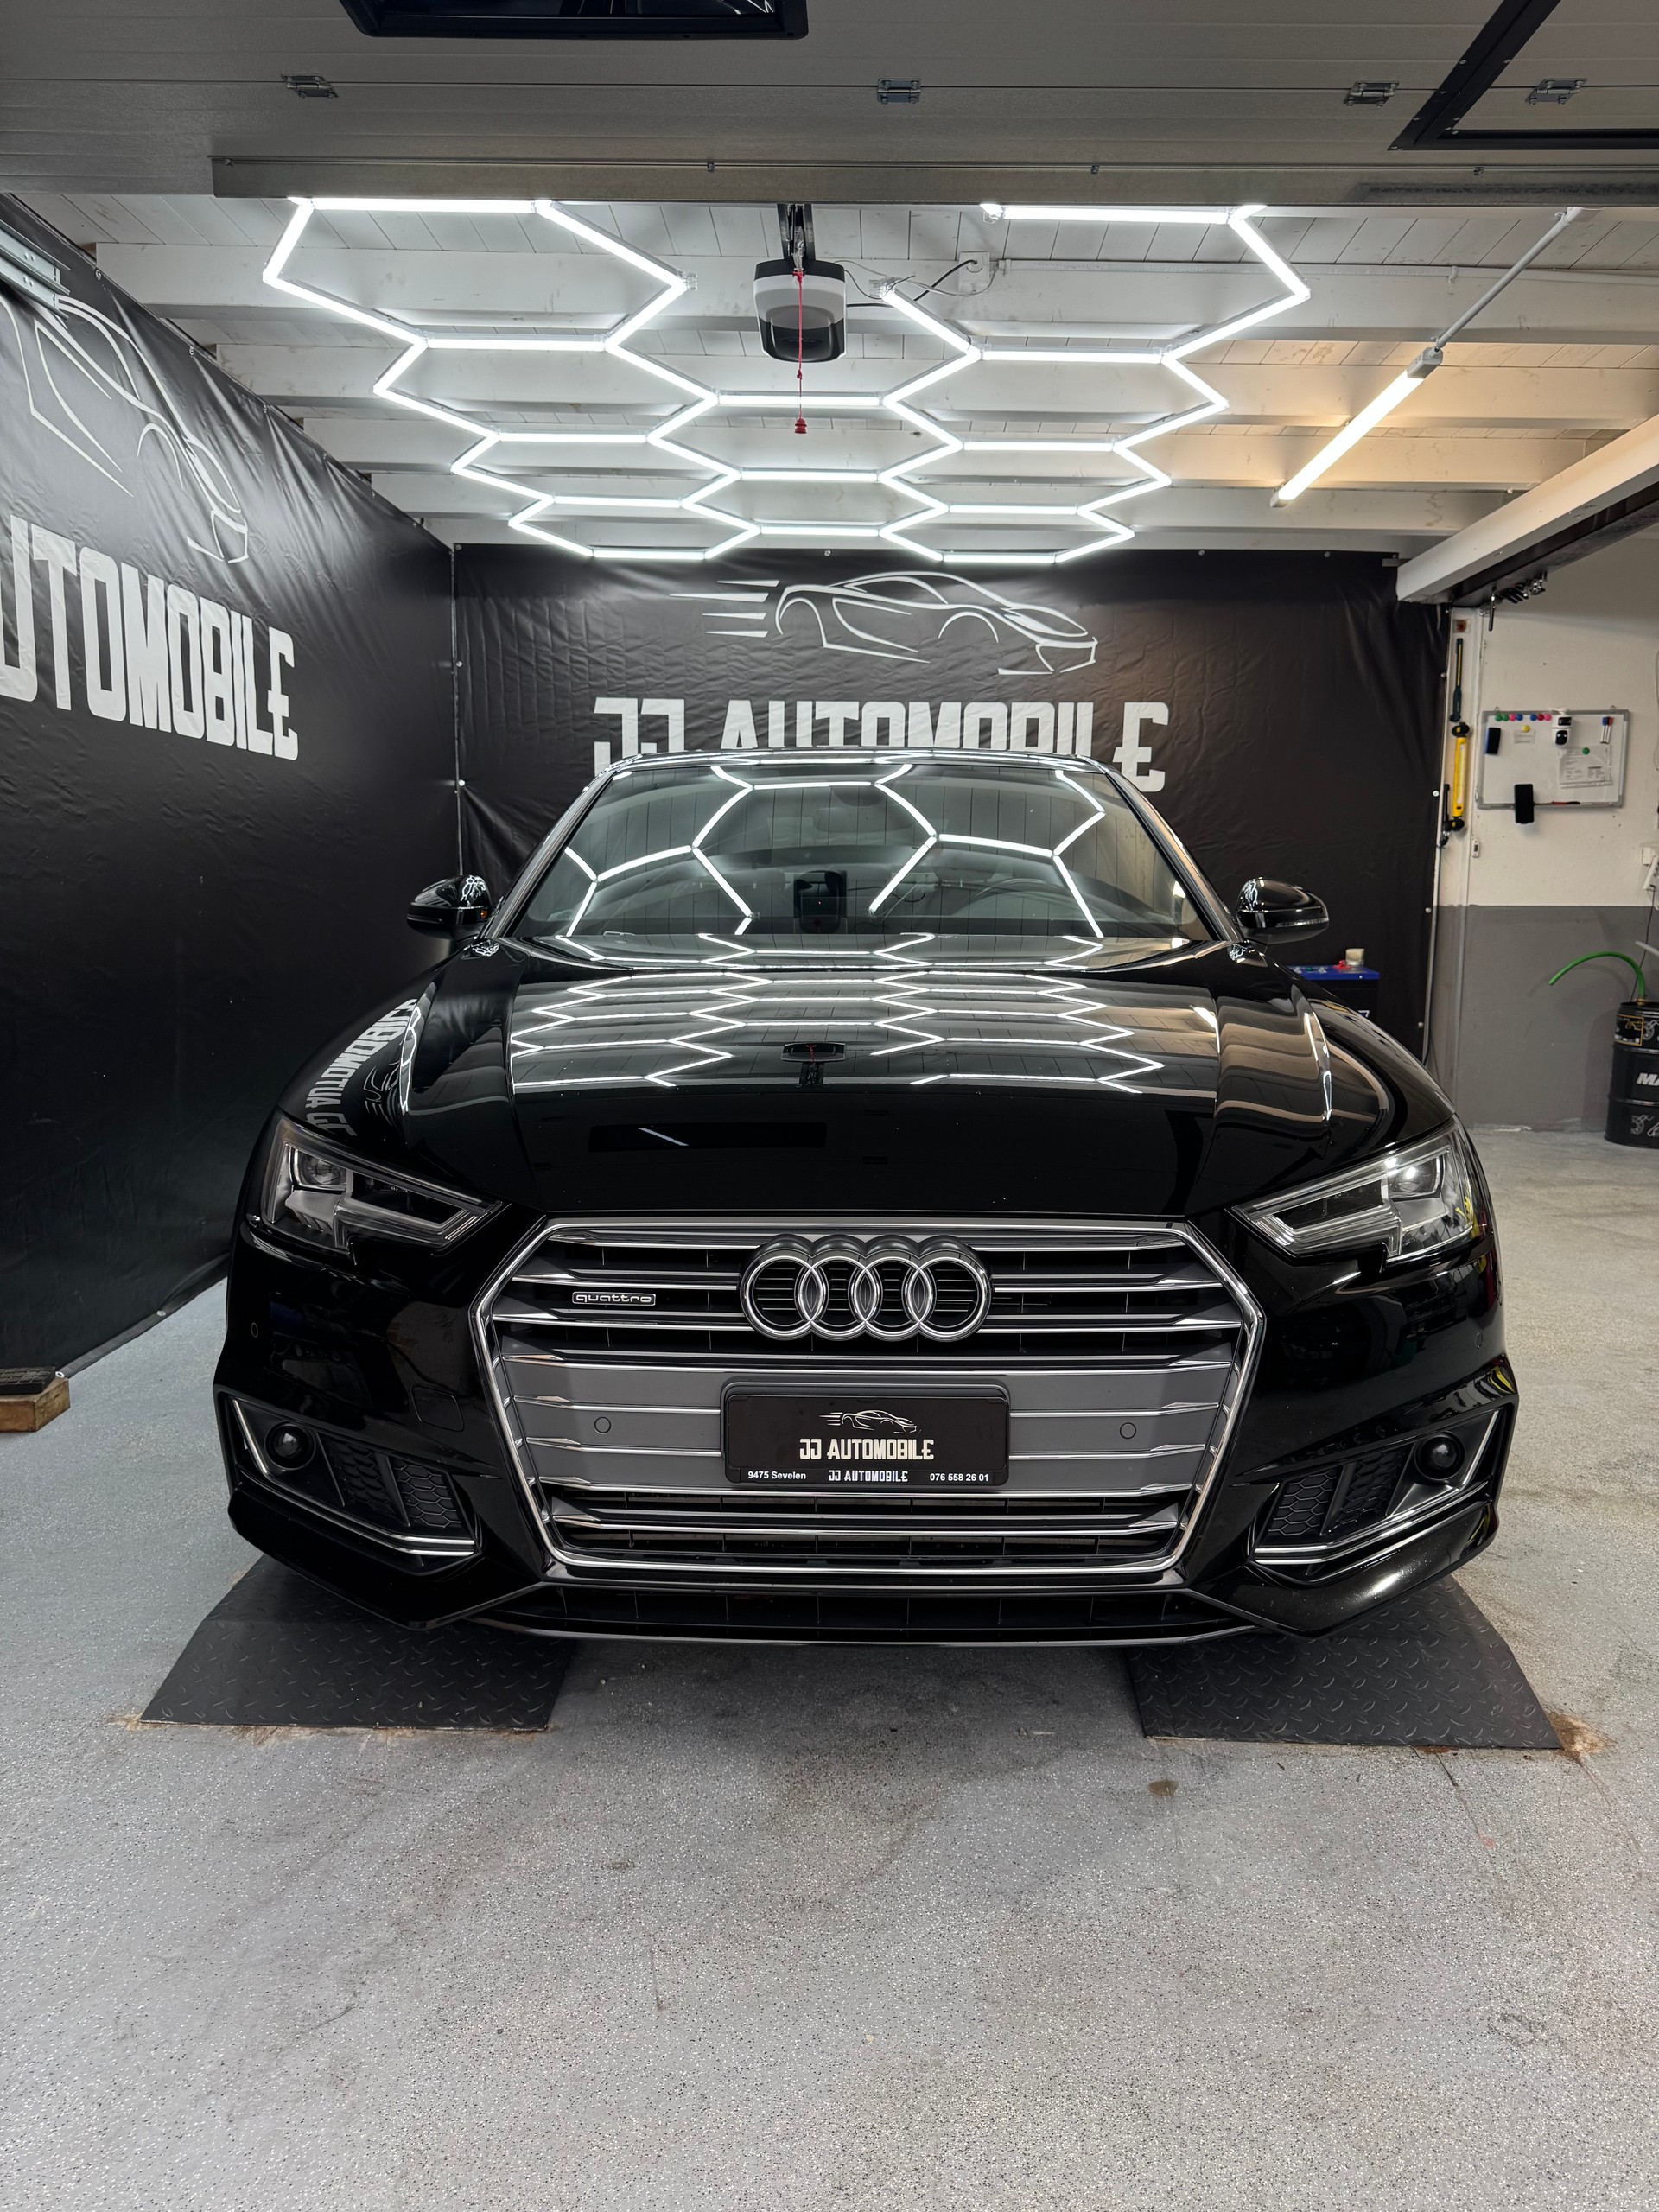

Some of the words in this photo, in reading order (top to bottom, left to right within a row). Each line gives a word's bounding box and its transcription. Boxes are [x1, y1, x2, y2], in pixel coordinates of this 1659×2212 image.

[575, 1294, 652, 1303] quattro
[799, 1438, 822, 1460] JJ
[827, 1438, 935, 1460] AUTOMOBILE
[747, 1471, 769, 1479] 9475
[771, 1471, 807, 1480] Sevelen
[829, 1470, 842, 1482] JJ
[844, 1470, 909, 1483] AUTOMOBILE
[930, 1472, 946, 1482] 076
[948, 1472, 963, 1482] 558
[965, 1472, 977, 1482] 26
[978, 1472, 989, 1482] 01
